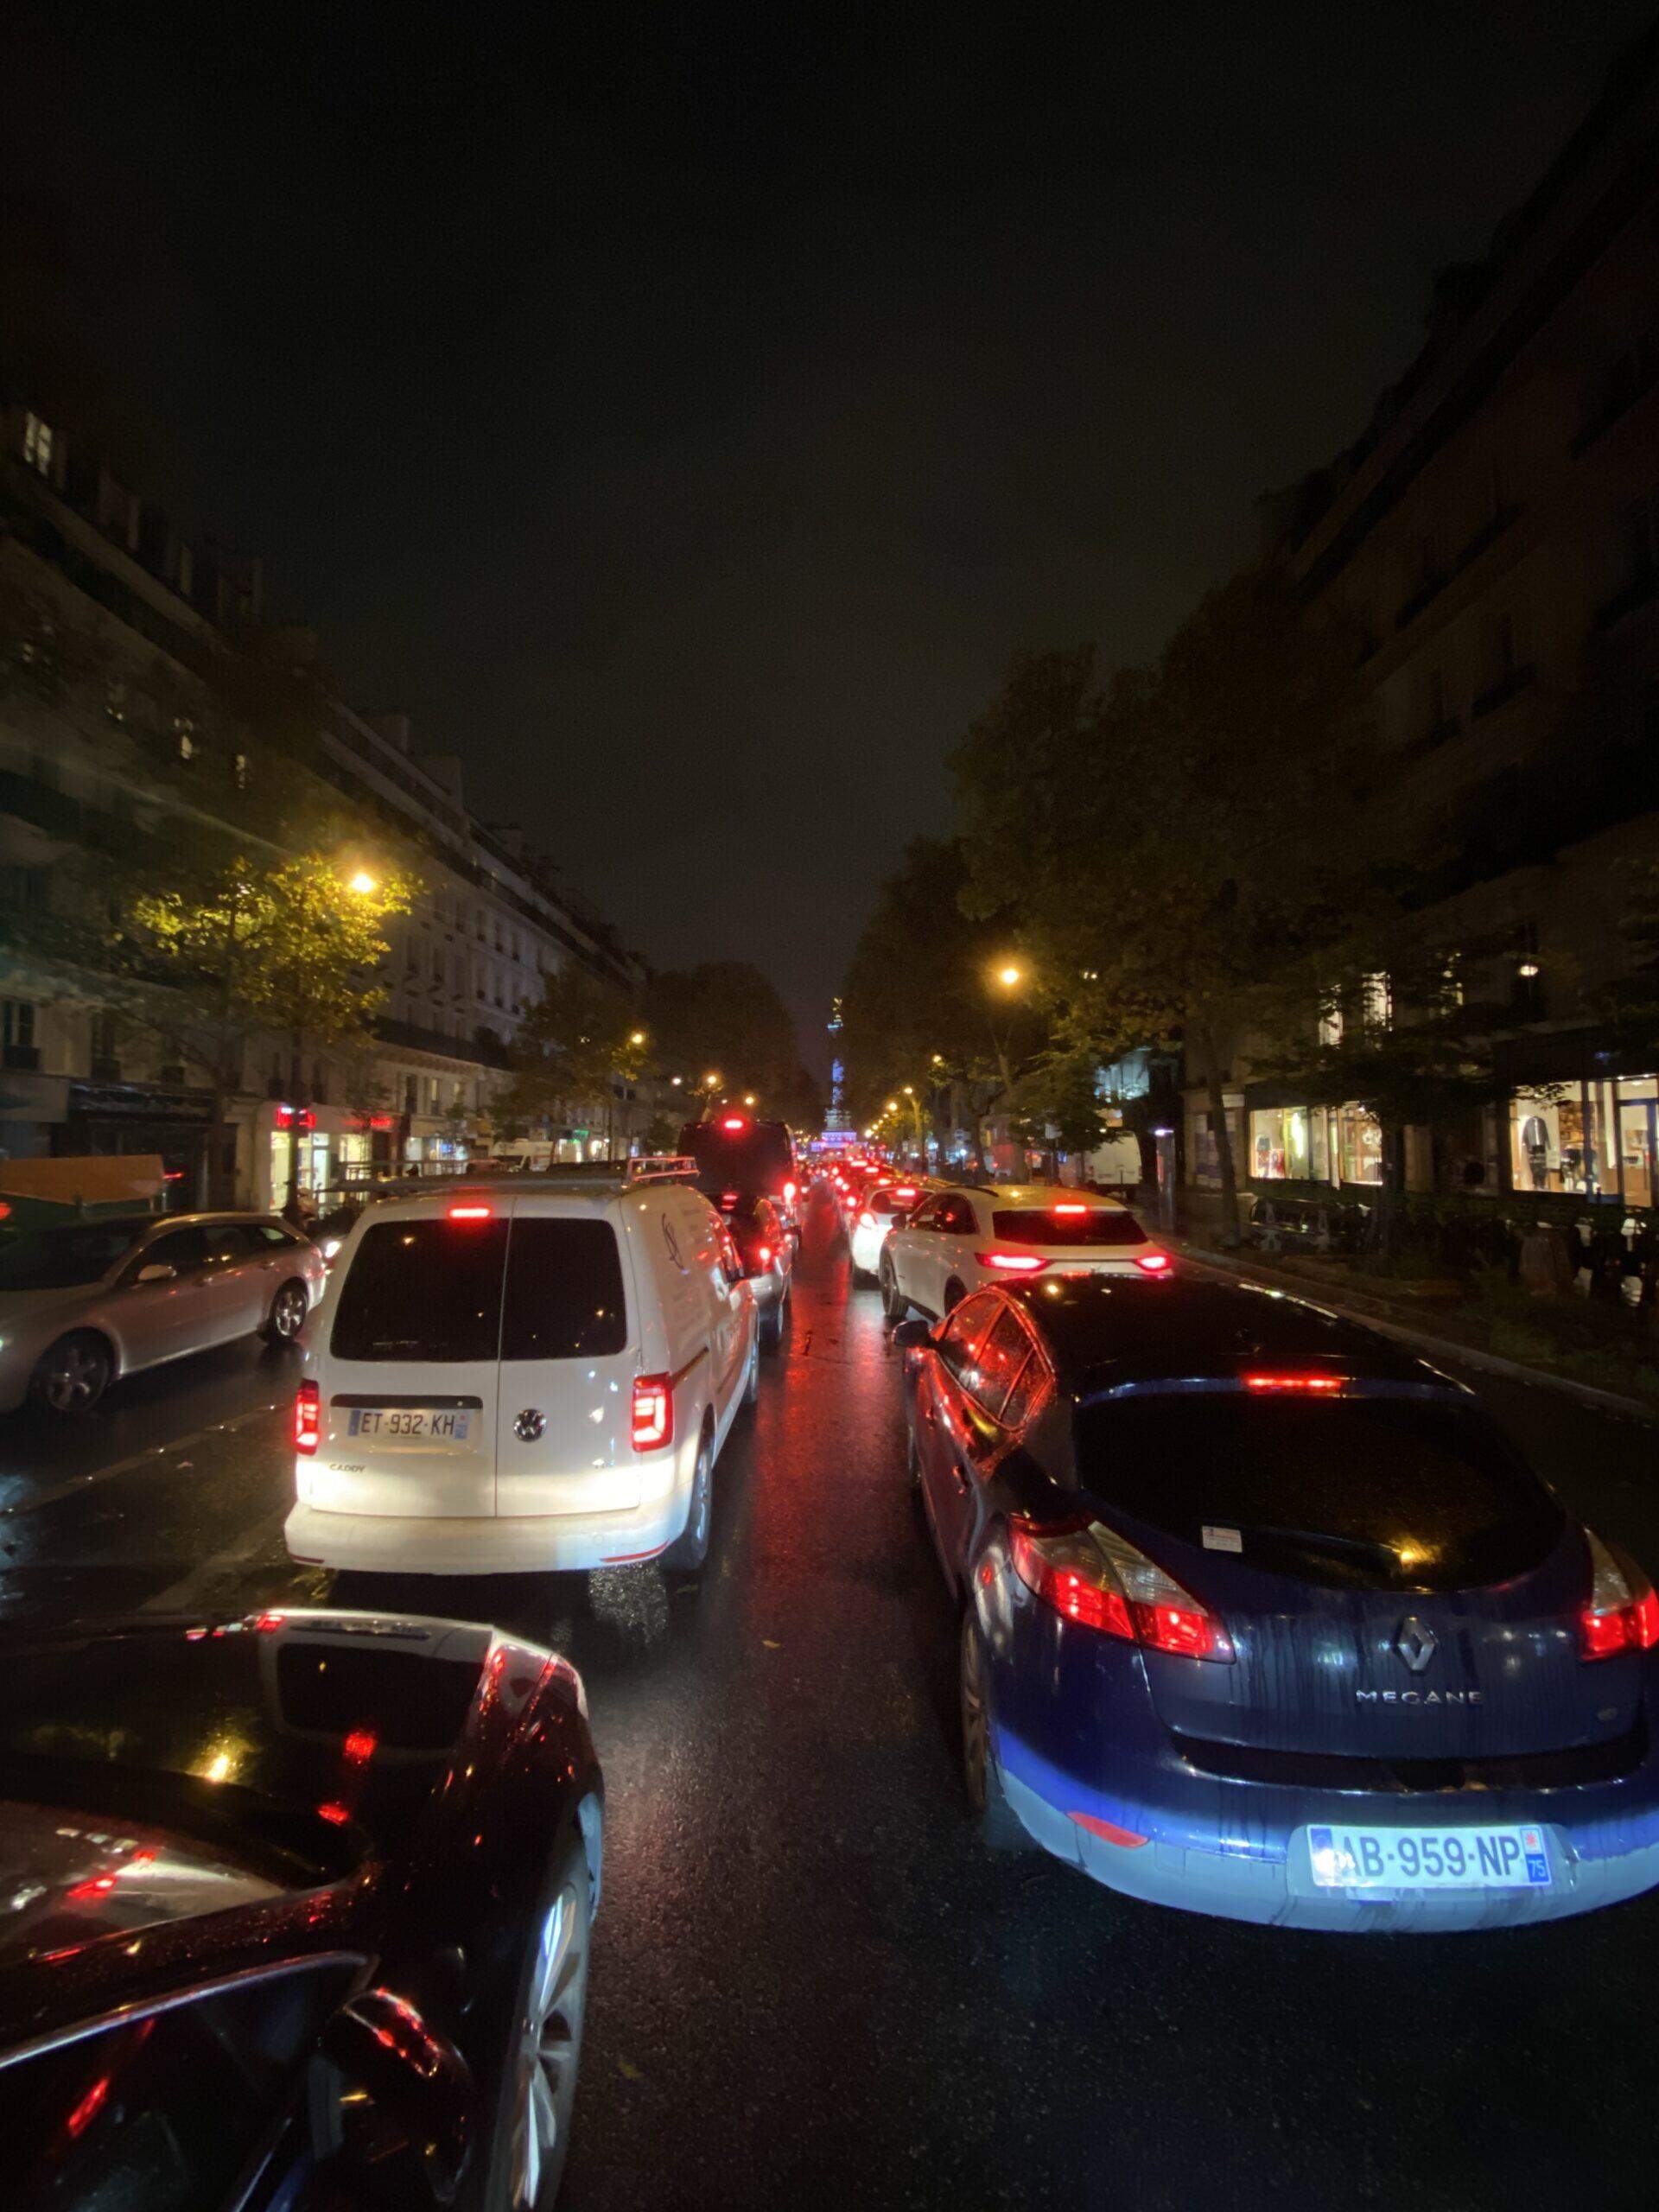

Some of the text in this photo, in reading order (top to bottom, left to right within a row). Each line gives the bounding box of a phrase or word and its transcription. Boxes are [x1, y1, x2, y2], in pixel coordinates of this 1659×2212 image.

[360, 1412, 455, 1436] ET-932-KH
[1355, 1688, 1483, 1706] MEGANE
[1341, 1834, 1521, 1878] AB-959-NP
[1528, 1859, 1548, 1878] 75
